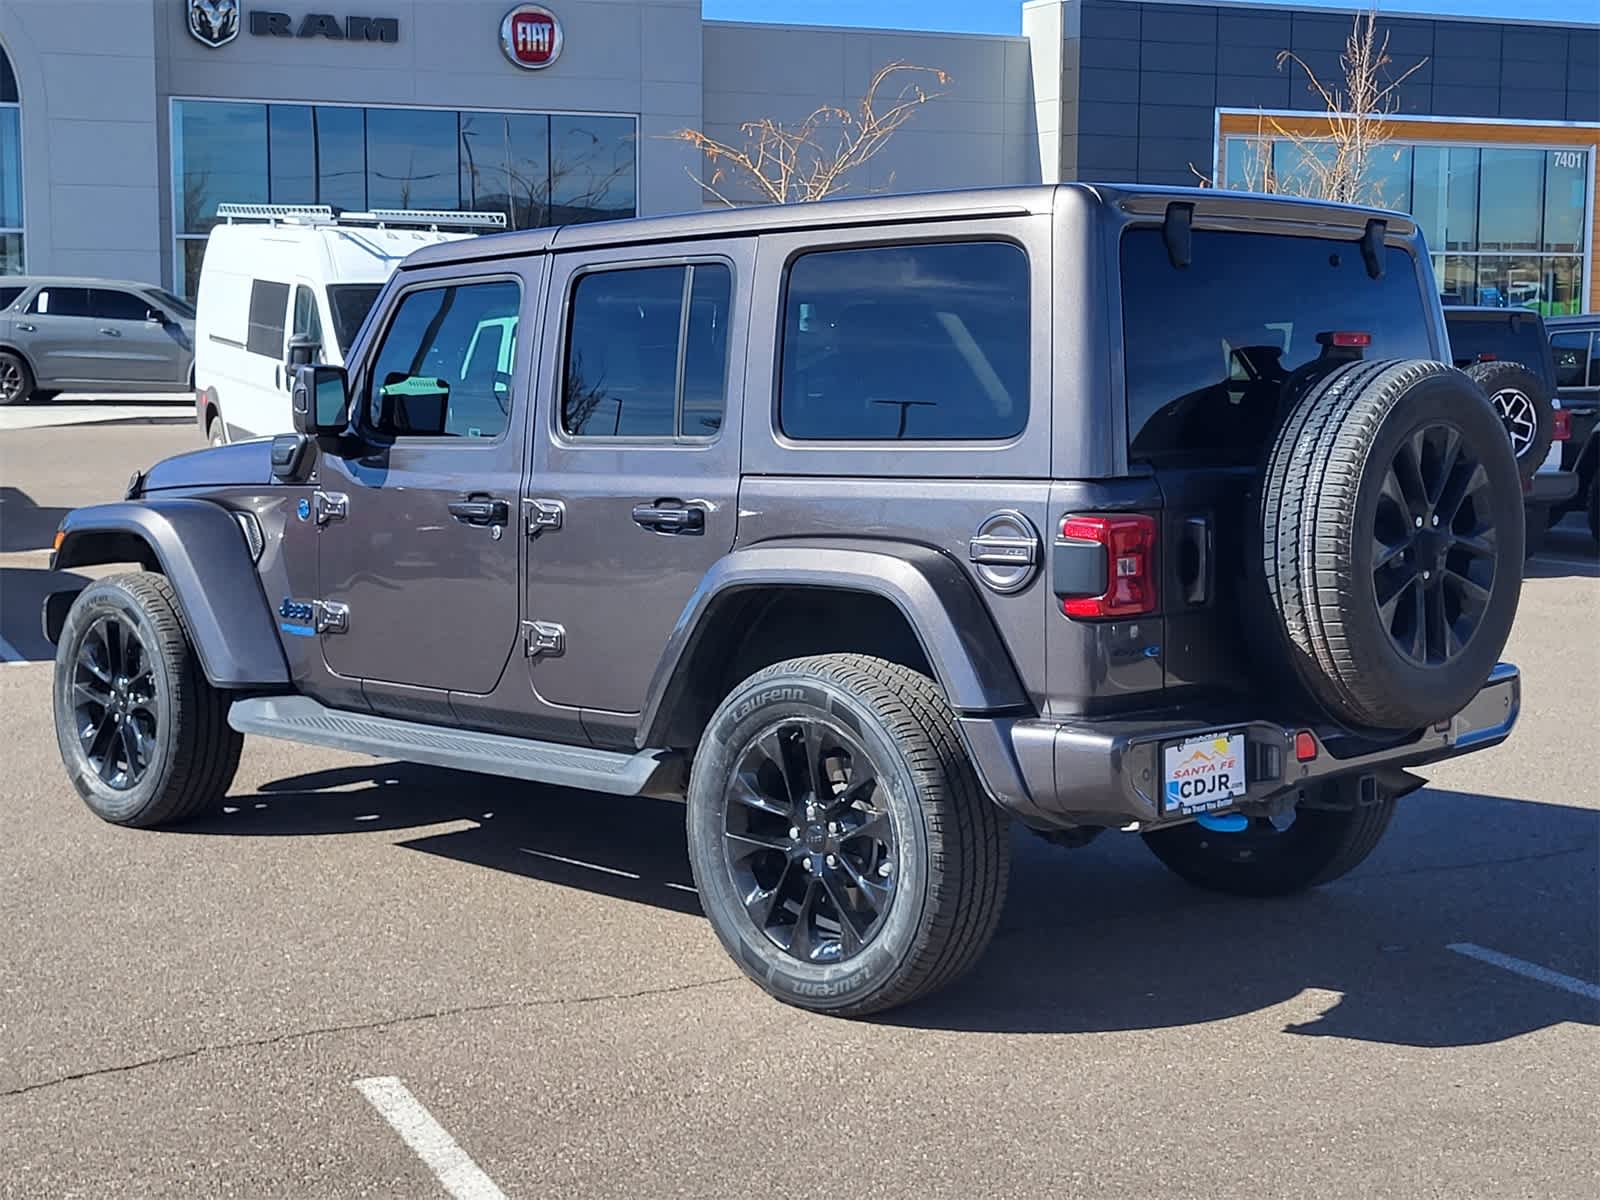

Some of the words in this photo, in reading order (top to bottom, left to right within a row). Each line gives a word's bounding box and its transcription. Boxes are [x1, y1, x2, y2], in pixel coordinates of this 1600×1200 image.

[249, 11, 398, 43] RAM
[517, 22, 551, 52] FIAT
[1553, 151, 1582, 168] 7401
[1173, 763, 1216, 779] SANTA
[1220, 758, 1236, 770] FE
